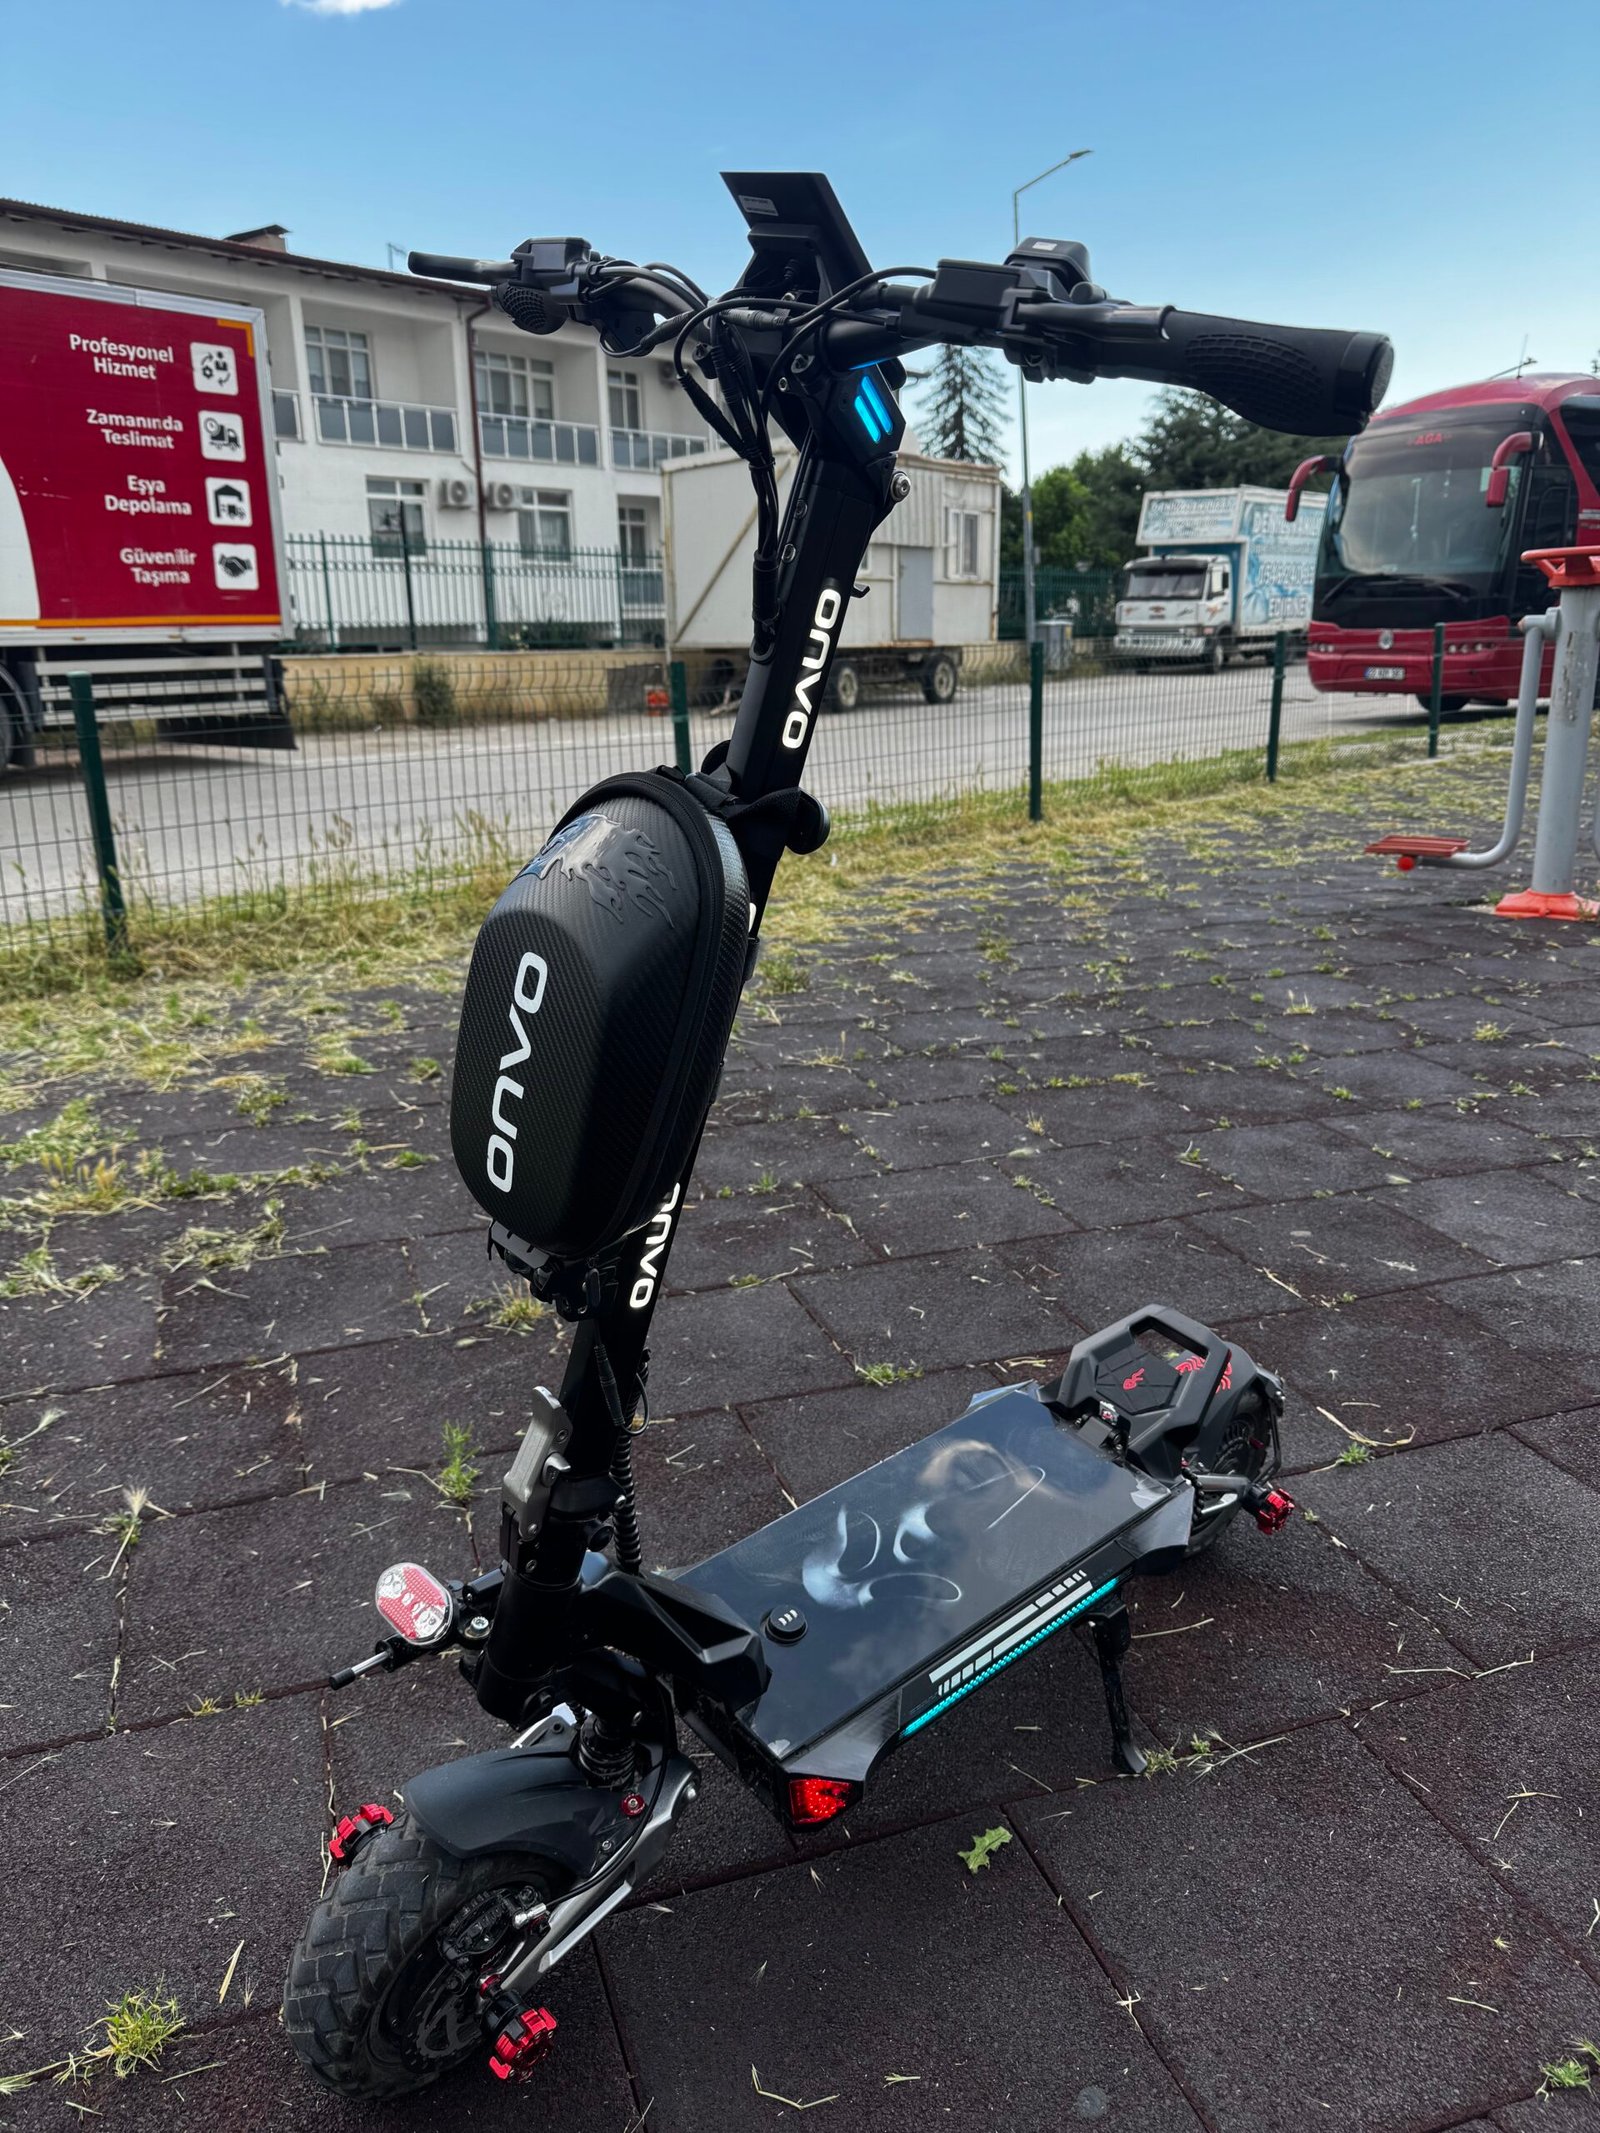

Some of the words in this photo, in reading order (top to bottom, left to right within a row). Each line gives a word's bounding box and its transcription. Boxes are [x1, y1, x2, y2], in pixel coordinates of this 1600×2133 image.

[69, 333, 174, 363] Profesyonel
[93, 356, 157, 380] Hizmet
[86, 408, 184, 432] Zamanında
[101, 428, 175, 449] Teslimat
[127, 474, 166, 496] Eşya
[104, 494, 192, 516] Depolama
[120, 547, 197, 565] Güvenilir
[130, 567, 191, 587] Taşıma
